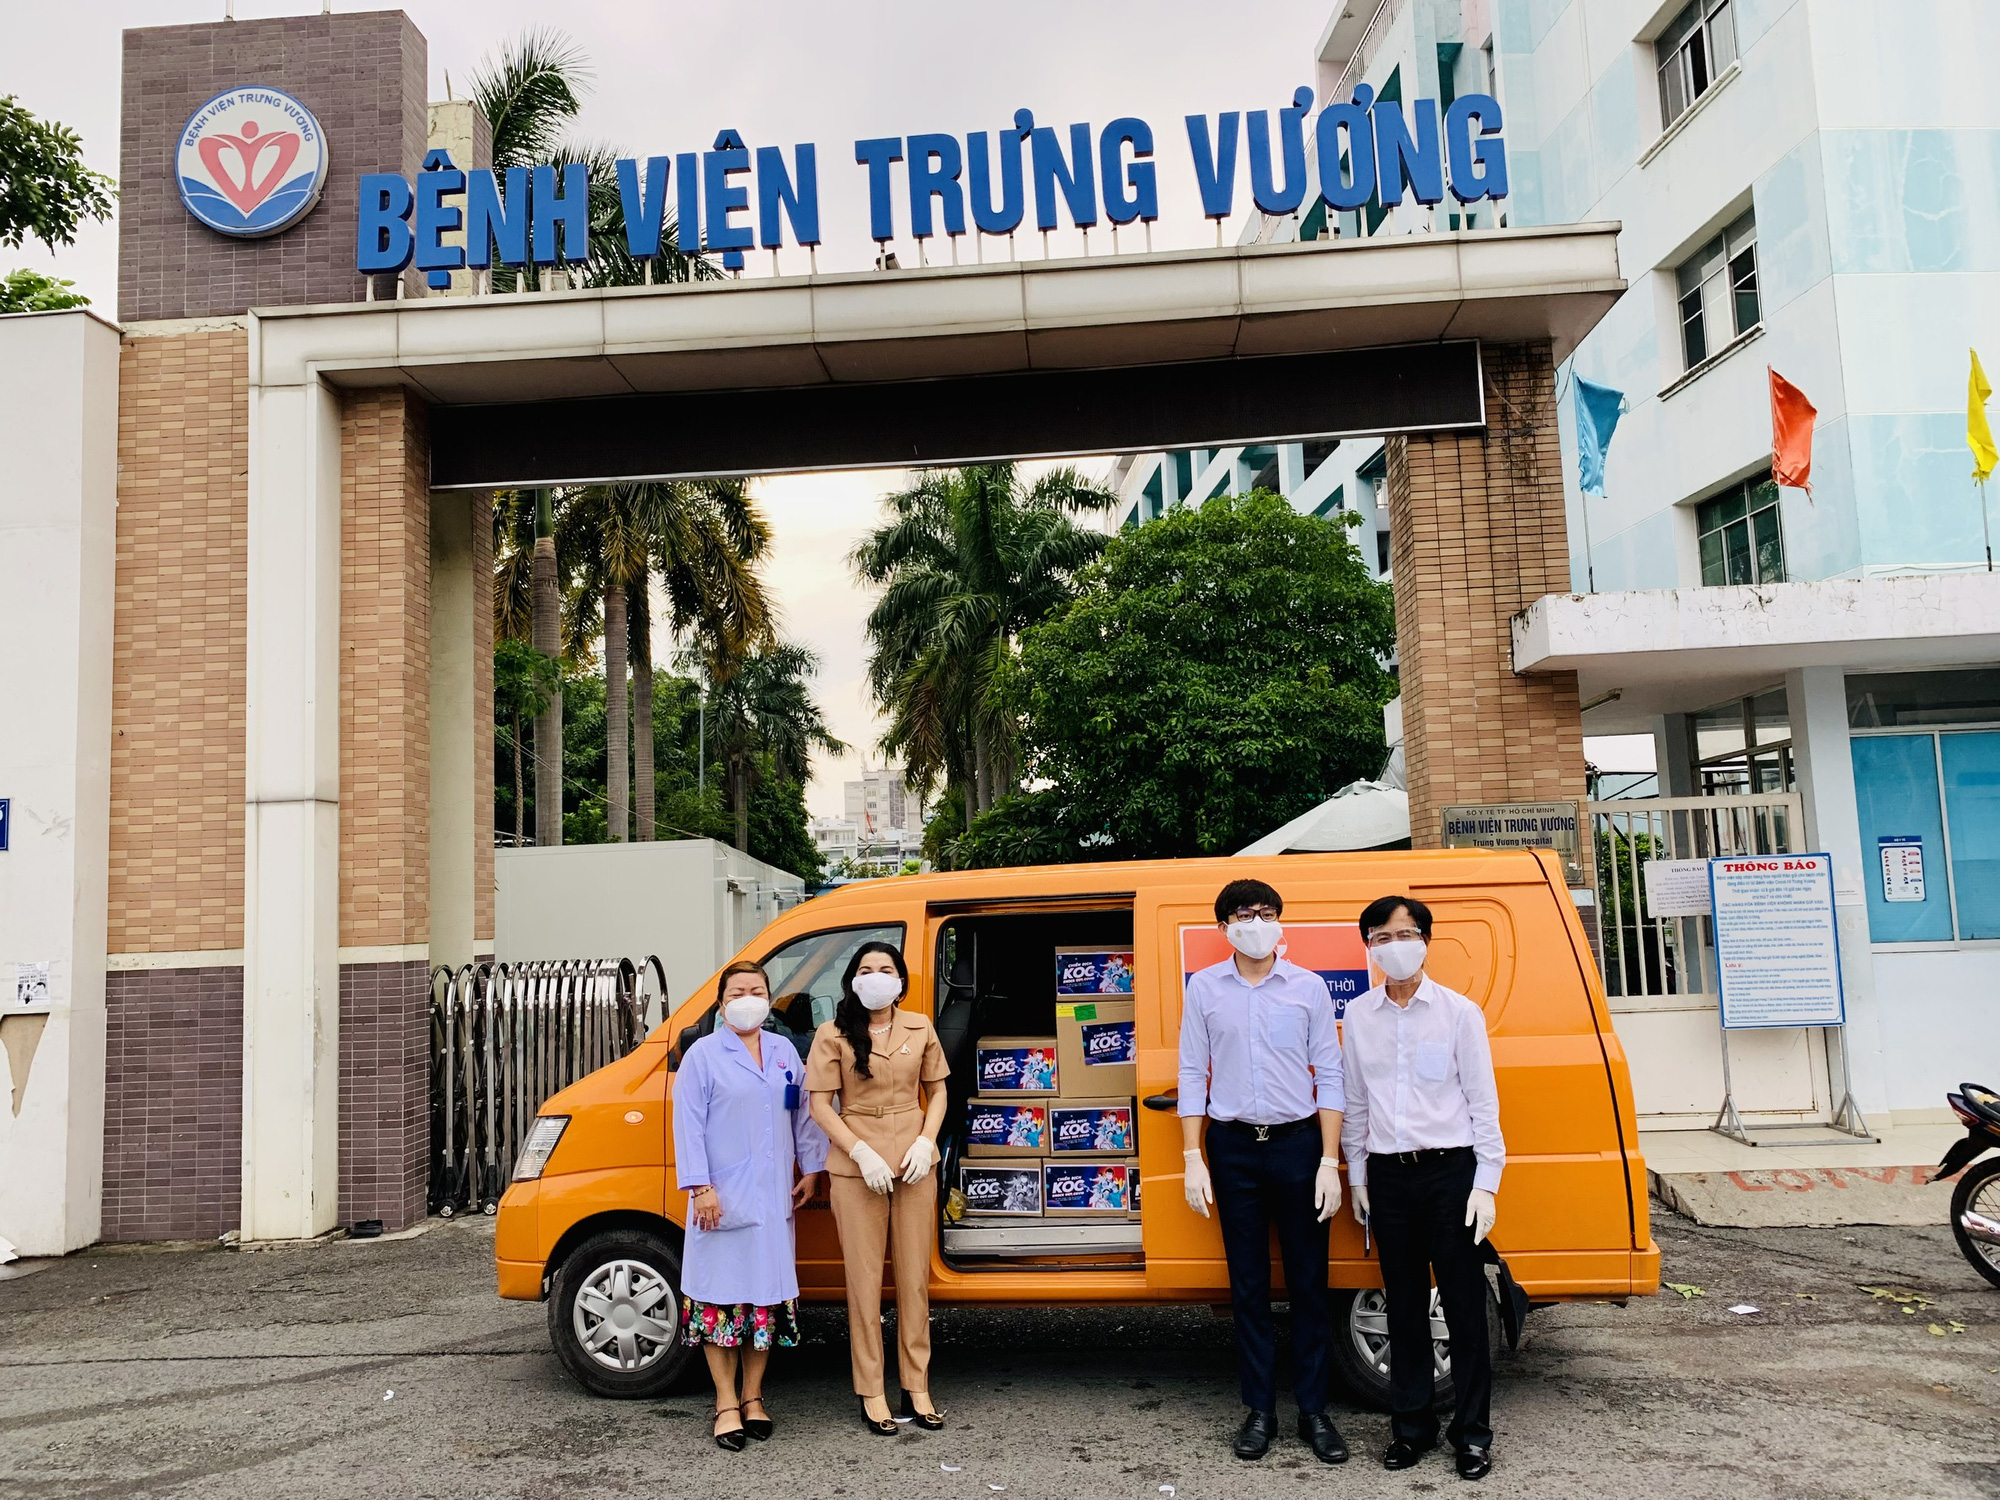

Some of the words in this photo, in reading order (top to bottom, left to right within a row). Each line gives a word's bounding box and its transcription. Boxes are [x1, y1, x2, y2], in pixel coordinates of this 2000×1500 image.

[185, 114, 209, 147] BỆNH
[208, 97, 235, 116] VIỆN
[238, 93, 282, 108] TRƯNG
[284, 103, 314, 143] VƯƠNG
[357, 148, 589, 290] BỆNH
[615, 128, 822, 271] VIỆN
[854, 107, 1158, 241] TRƯNG
[1184, 82, 1509, 218] VƯƠNG
[1448, 817, 1476, 838] BỆNH
[1478, 816, 1502, 837] VIỆN
[1504, 817, 1538, 833] TRƯNG
[1540, 815, 1575, 831] VƯƠNG
[1521, 837, 1552, 846] Hospital
[1723, 860, 1779, 873] THÔNG
[1783, 859, 1817, 871] BÁO
[1063, 965, 1095, 980] KOC
[1326, 977, 1356, 992] THỜI
[1089, 1034, 1121, 1051] KOC
[984, 1060, 1016, 1075] KOC
[971, 1118, 1004, 1131] KOC
[1059, 1122, 1090, 1137] KOC
[967, 1182, 1000, 1196] KOC
[1052, 1179, 1085, 1194] KOC
